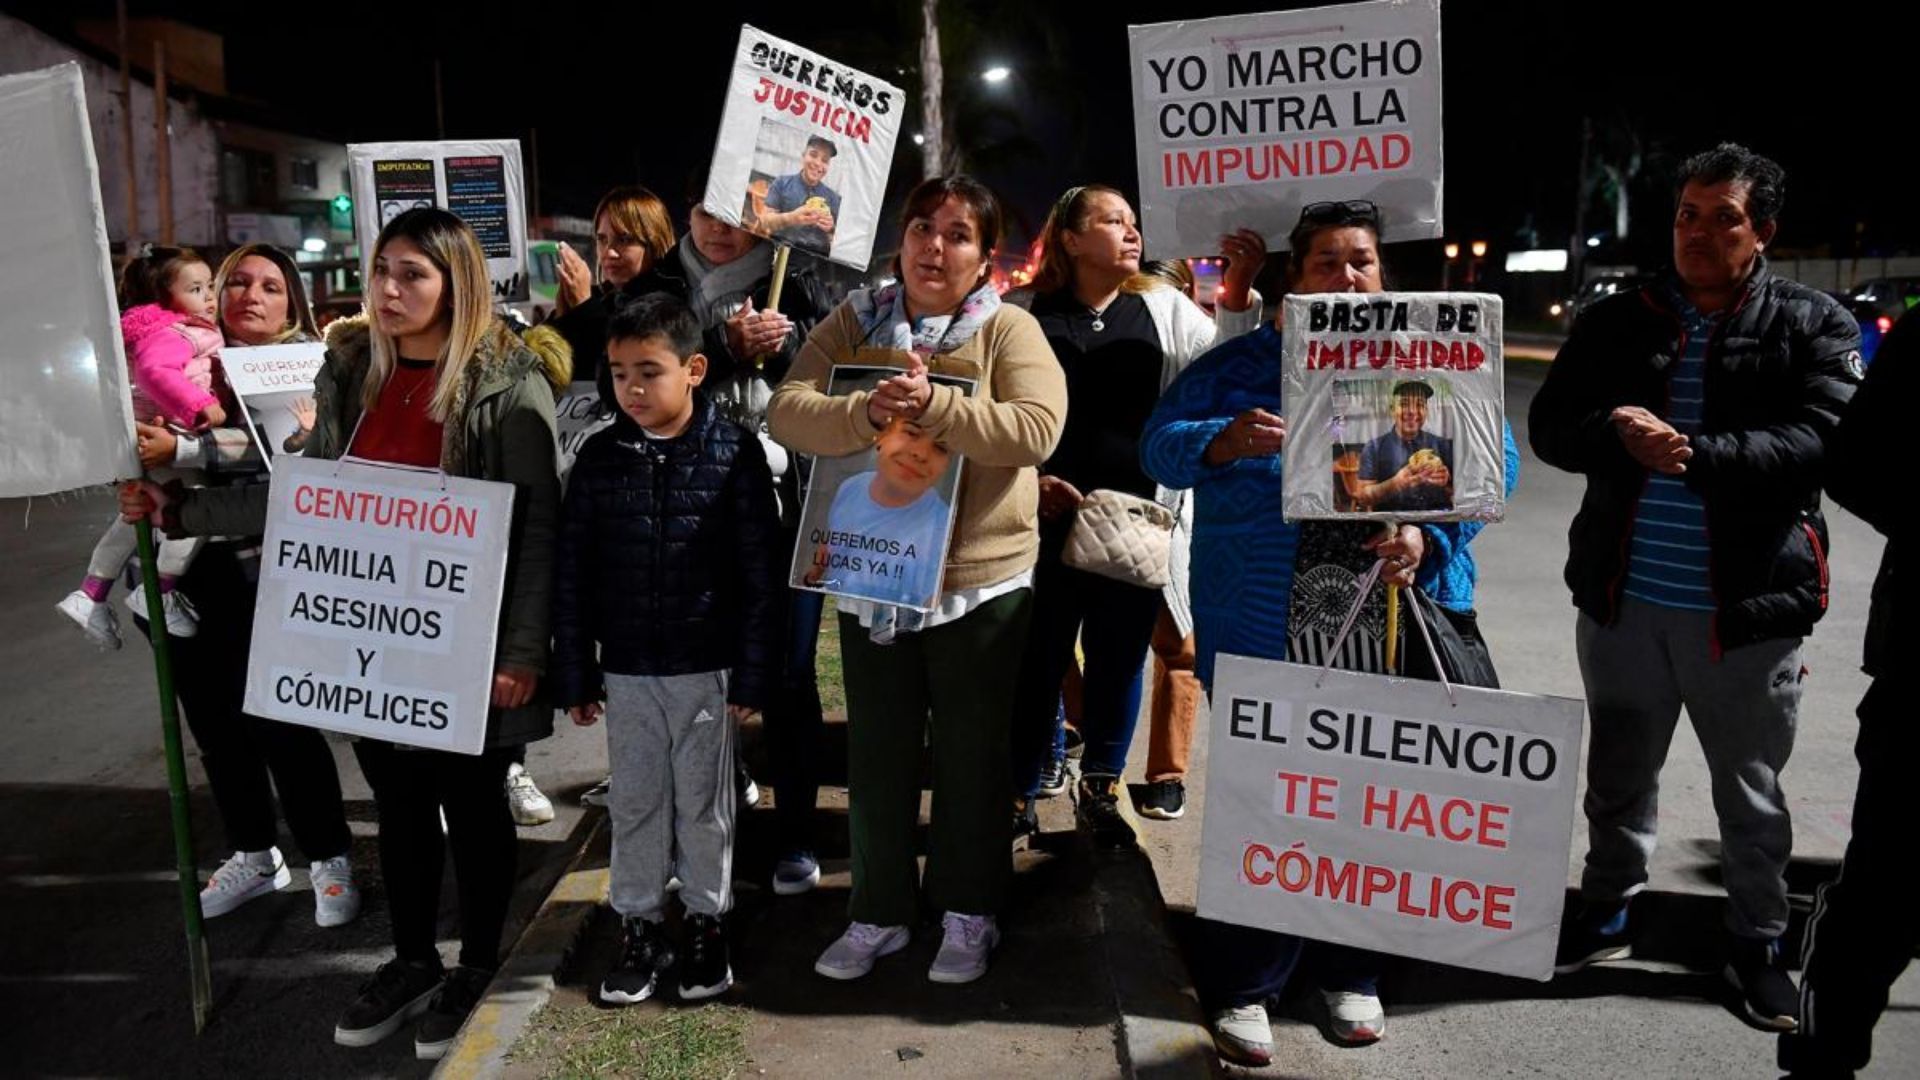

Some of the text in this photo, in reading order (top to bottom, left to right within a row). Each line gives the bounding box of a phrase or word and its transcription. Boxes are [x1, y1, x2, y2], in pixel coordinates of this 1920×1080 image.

[750, 42, 892, 115] QUEREMOS
[1148, 39, 1422, 93] YO MARCHO
[754, 76, 872, 144] JUSTICIA
[1159, 88, 1406, 139] CONTRA LA
[1163, 133, 1411, 187] IMPUNIDAD
[1309, 301, 1479, 332] BASTA DE
[242, 359, 325, 373] QUEREMO
[1307, 340, 1485, 370] IMPUNIDAD
[294, 485, 477, 538] CENTURIÓN
[278, 540, 468, 593] FAMILIA DE
[810, 529, 916, 558] QUEREMOS A
[813, 553, 904, 578] LUCAS YA !!
[290, 592, 442, 639] ASESINOS
[356, 649, 376, 677] Y
[275, 672, 449, 730] CÓMPLICES
[1229, 698, 1556, 782] EL SILENCIO
[1277, 771, 1511, 848] TE HACE
[1241, 841, 1516, 930] CÓMPLICE
